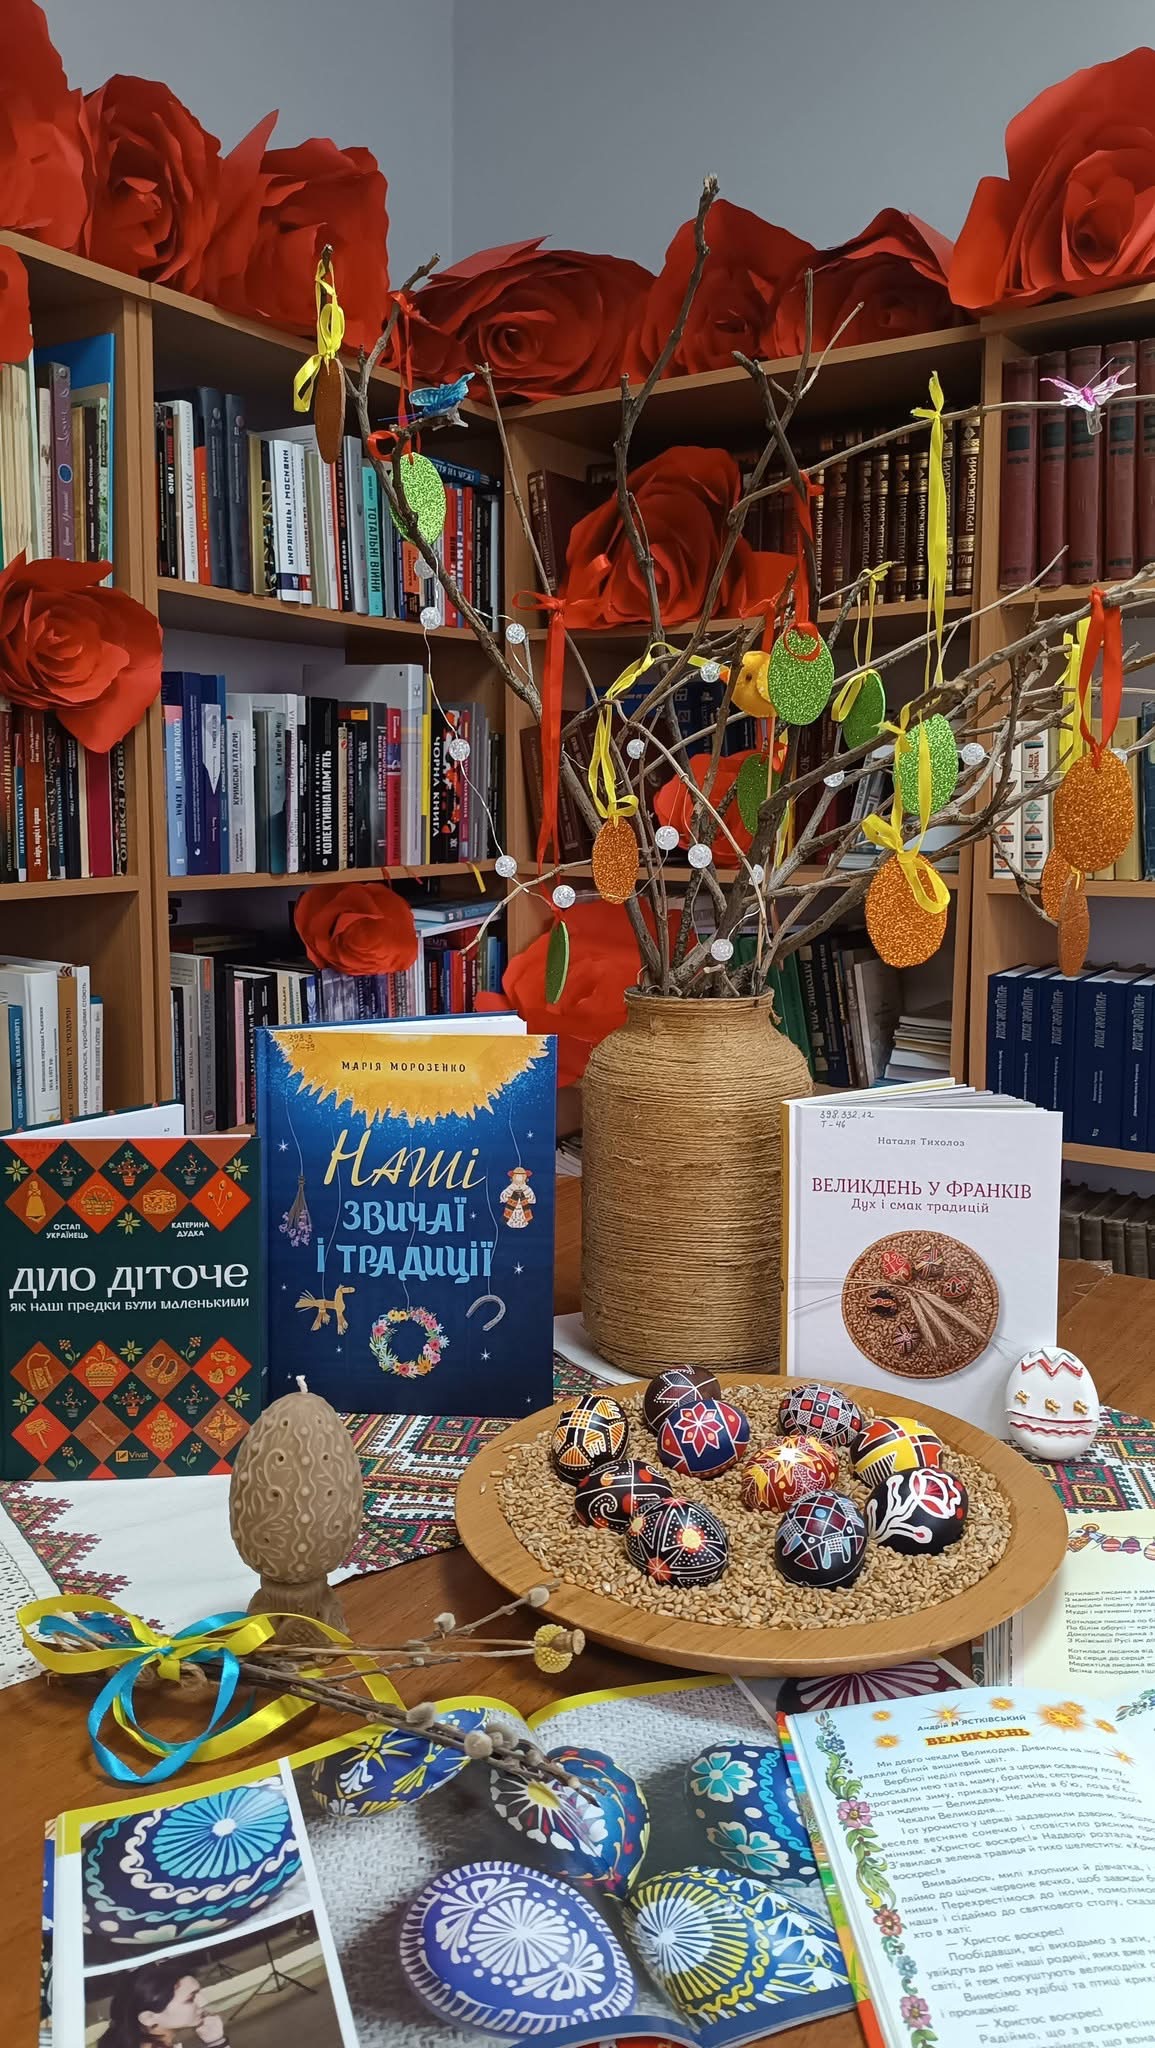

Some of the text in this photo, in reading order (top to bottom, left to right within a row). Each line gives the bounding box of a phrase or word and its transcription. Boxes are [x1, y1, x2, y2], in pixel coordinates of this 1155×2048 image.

[966, 456, 978, 531] ГРУШЕВСЬКИЙ
[367, 507, 379, 557] ТОТАЛЬНІ
[369, 560, 381, 593] ВІЙНИ
[433, 736, 441, 787] ЧОРНА
[232, 765, 240, 806] КРИМСЬКІ
[323, 750, 333, 855] КОЛЕКТИВНА ПАМ'ЯТЬ
[342, 1061, 466, 1073] МАРІЯ МОРОЗЕНКО
[878, 1137, 965, 1147] Наталя Тихолоз
[811, 1177, 1032, 1199] ВЕЛИКДЕНЬ У ФРАНКІВ
[851, 1198, 990, 1214] Дух і смак традицій
[343, 1197, 468, 1235] ЗВИЧАЇ
[171, 1221, 210, 1230] КАТЕРИНА
[176, 1229, 205, 1238] ДУДКА
[46, 1231, 89, 1240] УКРАЇНЕЦЬ
[316, 1238, 494, 1284] І ТРАДИЦІЇ
[9, 1263, 250, 1299] ДІЛО ДІТОЧЕ
[10, 1303, 28, 1312] ЯК
[30, 1302, 64, 1312] НАШІ
[125, 1299, 157, 1310] БУЛИ
[161, 1297, 250, 1310] МАЛЕНЬКИМИ
[926, 1729, 1030, 1746] ВЕЛИКДЕНЬ
[894, 1757, 923, 1768] довго
[924, 1752, 959, 1762] чекали
[900, 1757, 980, 1774] білий вишневий
[883, 1773, 924, 1786] Вербної
[927, 1769, 957, 1780] неділі
[959, 1766, 1006, 1777] принесли
[920, 1783, 941, 1791] нею
[885, 1805, 929, 1816] тиждень
[897, 1814, 936, 1824] Чекали
[921, 1822, 969, 1834] урочисто
[978, 1814, 1012, 1827] церкві
[881, 1838, 919, 1849] веселе
[923, 1832, 968, 1843] весняне
[971, 1826, 1017, 1837] сонечко
[944, 1852, 982, 1862] зелена
[983, 1847, 1026, 1858] травиця
[997, 1868, 1023, 1879] милі
[955, 1887, 988, 1898] щічок
[989, 1881, 1036, 1892] червоне
[950, 1902, 1083, 1920] сідаймо святкового
[963, 1926, 1064, 1946] Христос воскрес!
[1027, 1942, 1044, 1952] всі
[1047, 1939, 1105, 1950] виходьмо
[926, 1966, 976, 1979] увійдуть
[995, 1959, 1013, 1969] неї
[1015, 1956, 1044, 1967] наші
[1091, 1951, 1120, 1959] яких
[975, 1978, 999, 1986] теж
[1002, 1970, 1075, 1982] покуштують
[962, 1989, 1021, 2000] Винесімо
[1088, 1976, 1120, 1987] птиці
[993, 2017, 1046, 2027] Христос
